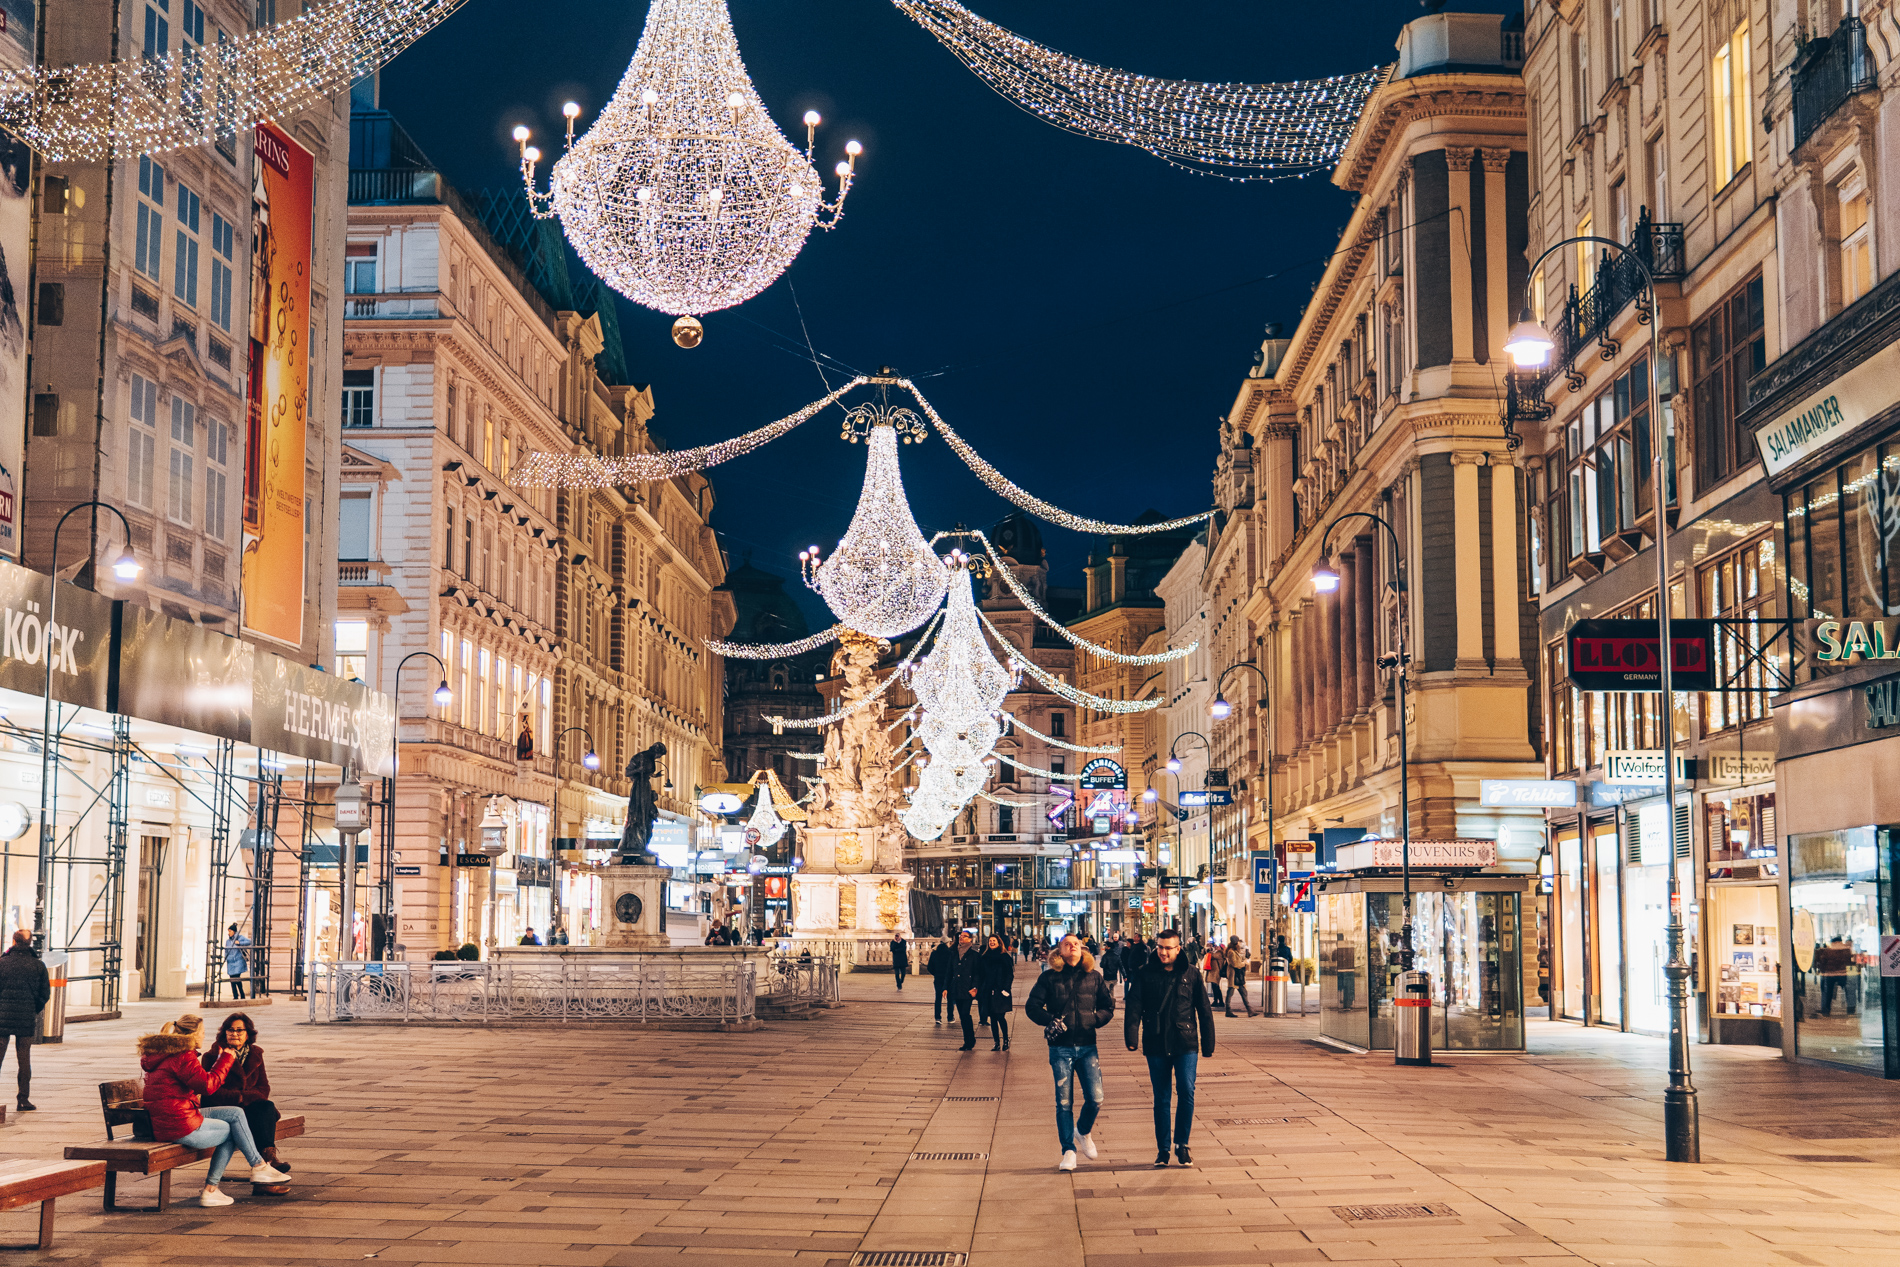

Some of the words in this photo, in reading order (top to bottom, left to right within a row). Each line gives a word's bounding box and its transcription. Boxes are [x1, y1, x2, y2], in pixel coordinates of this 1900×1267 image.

[1767, 395, 1845, 462] SALAMANDER
[276, 500, 301, 519] BESTSELLER
[1817, 621, 1900, 660] SAL
[1580, 643, 1701, 667] LLOYD
[1185, 793, 1225, 802] Berlitz
[1511, 787, 1571, 802] Tchibo
